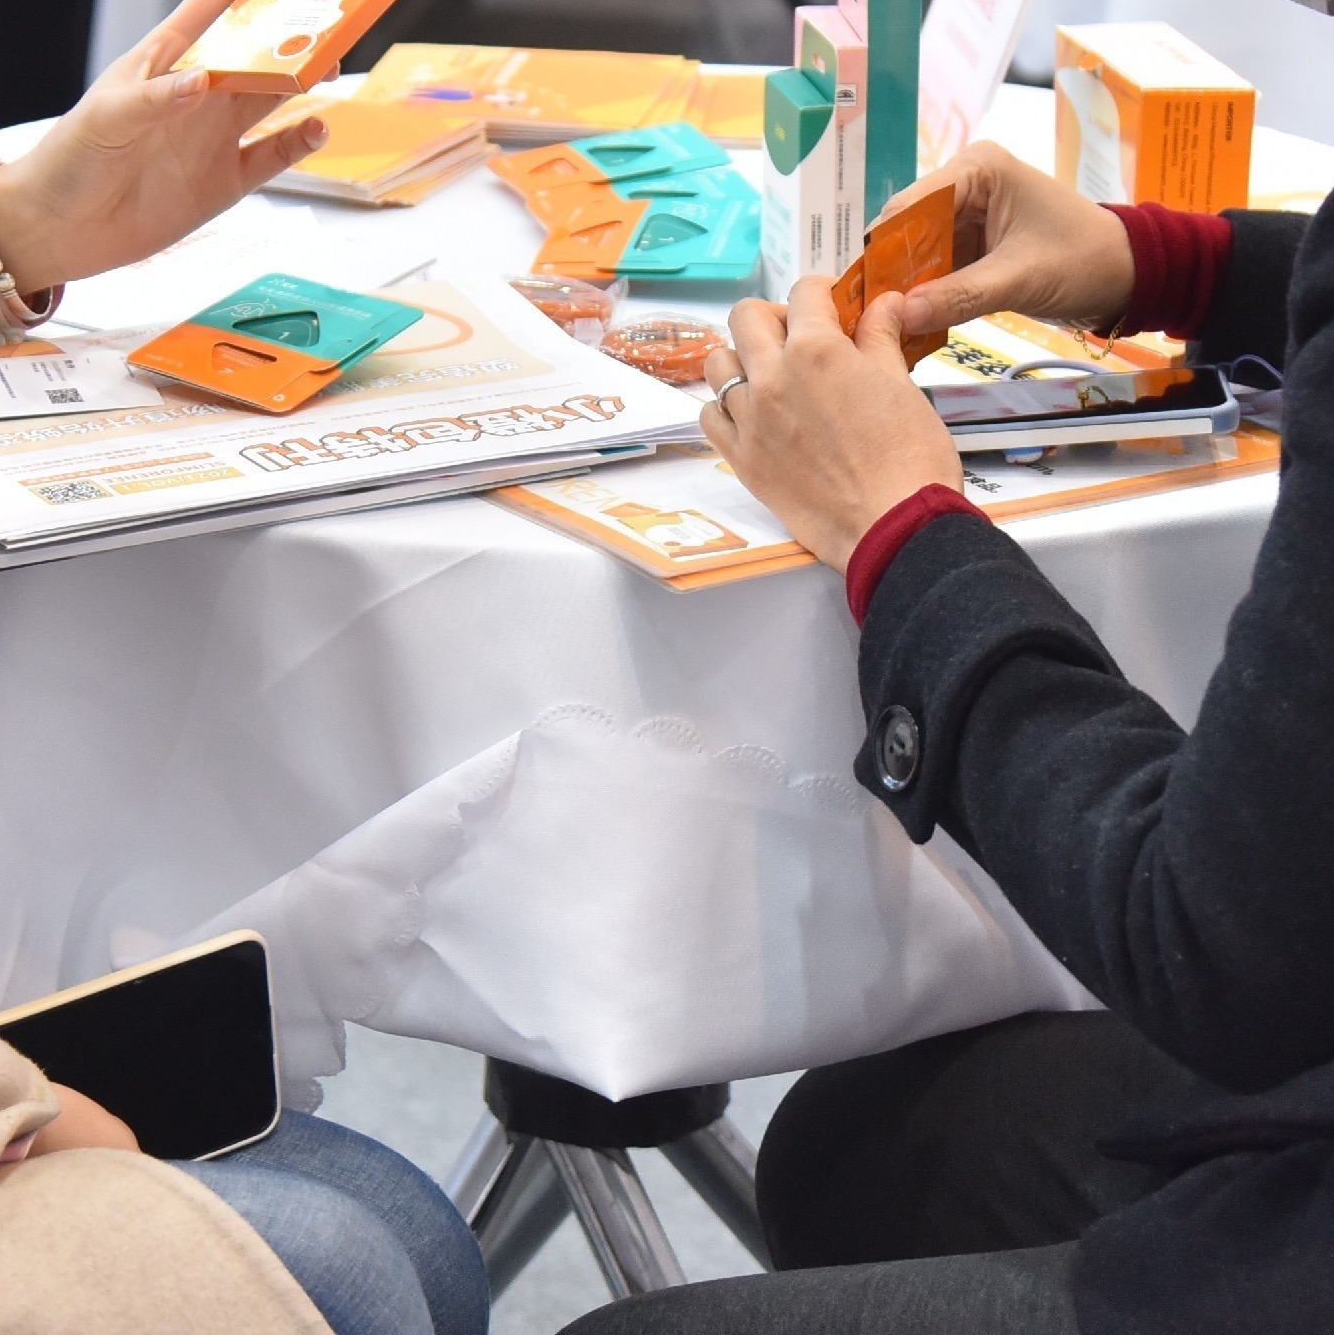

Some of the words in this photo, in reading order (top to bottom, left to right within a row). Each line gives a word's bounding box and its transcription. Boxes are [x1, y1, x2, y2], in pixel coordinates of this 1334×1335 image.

[239, 396, 625, 473] 小橙包特刊
